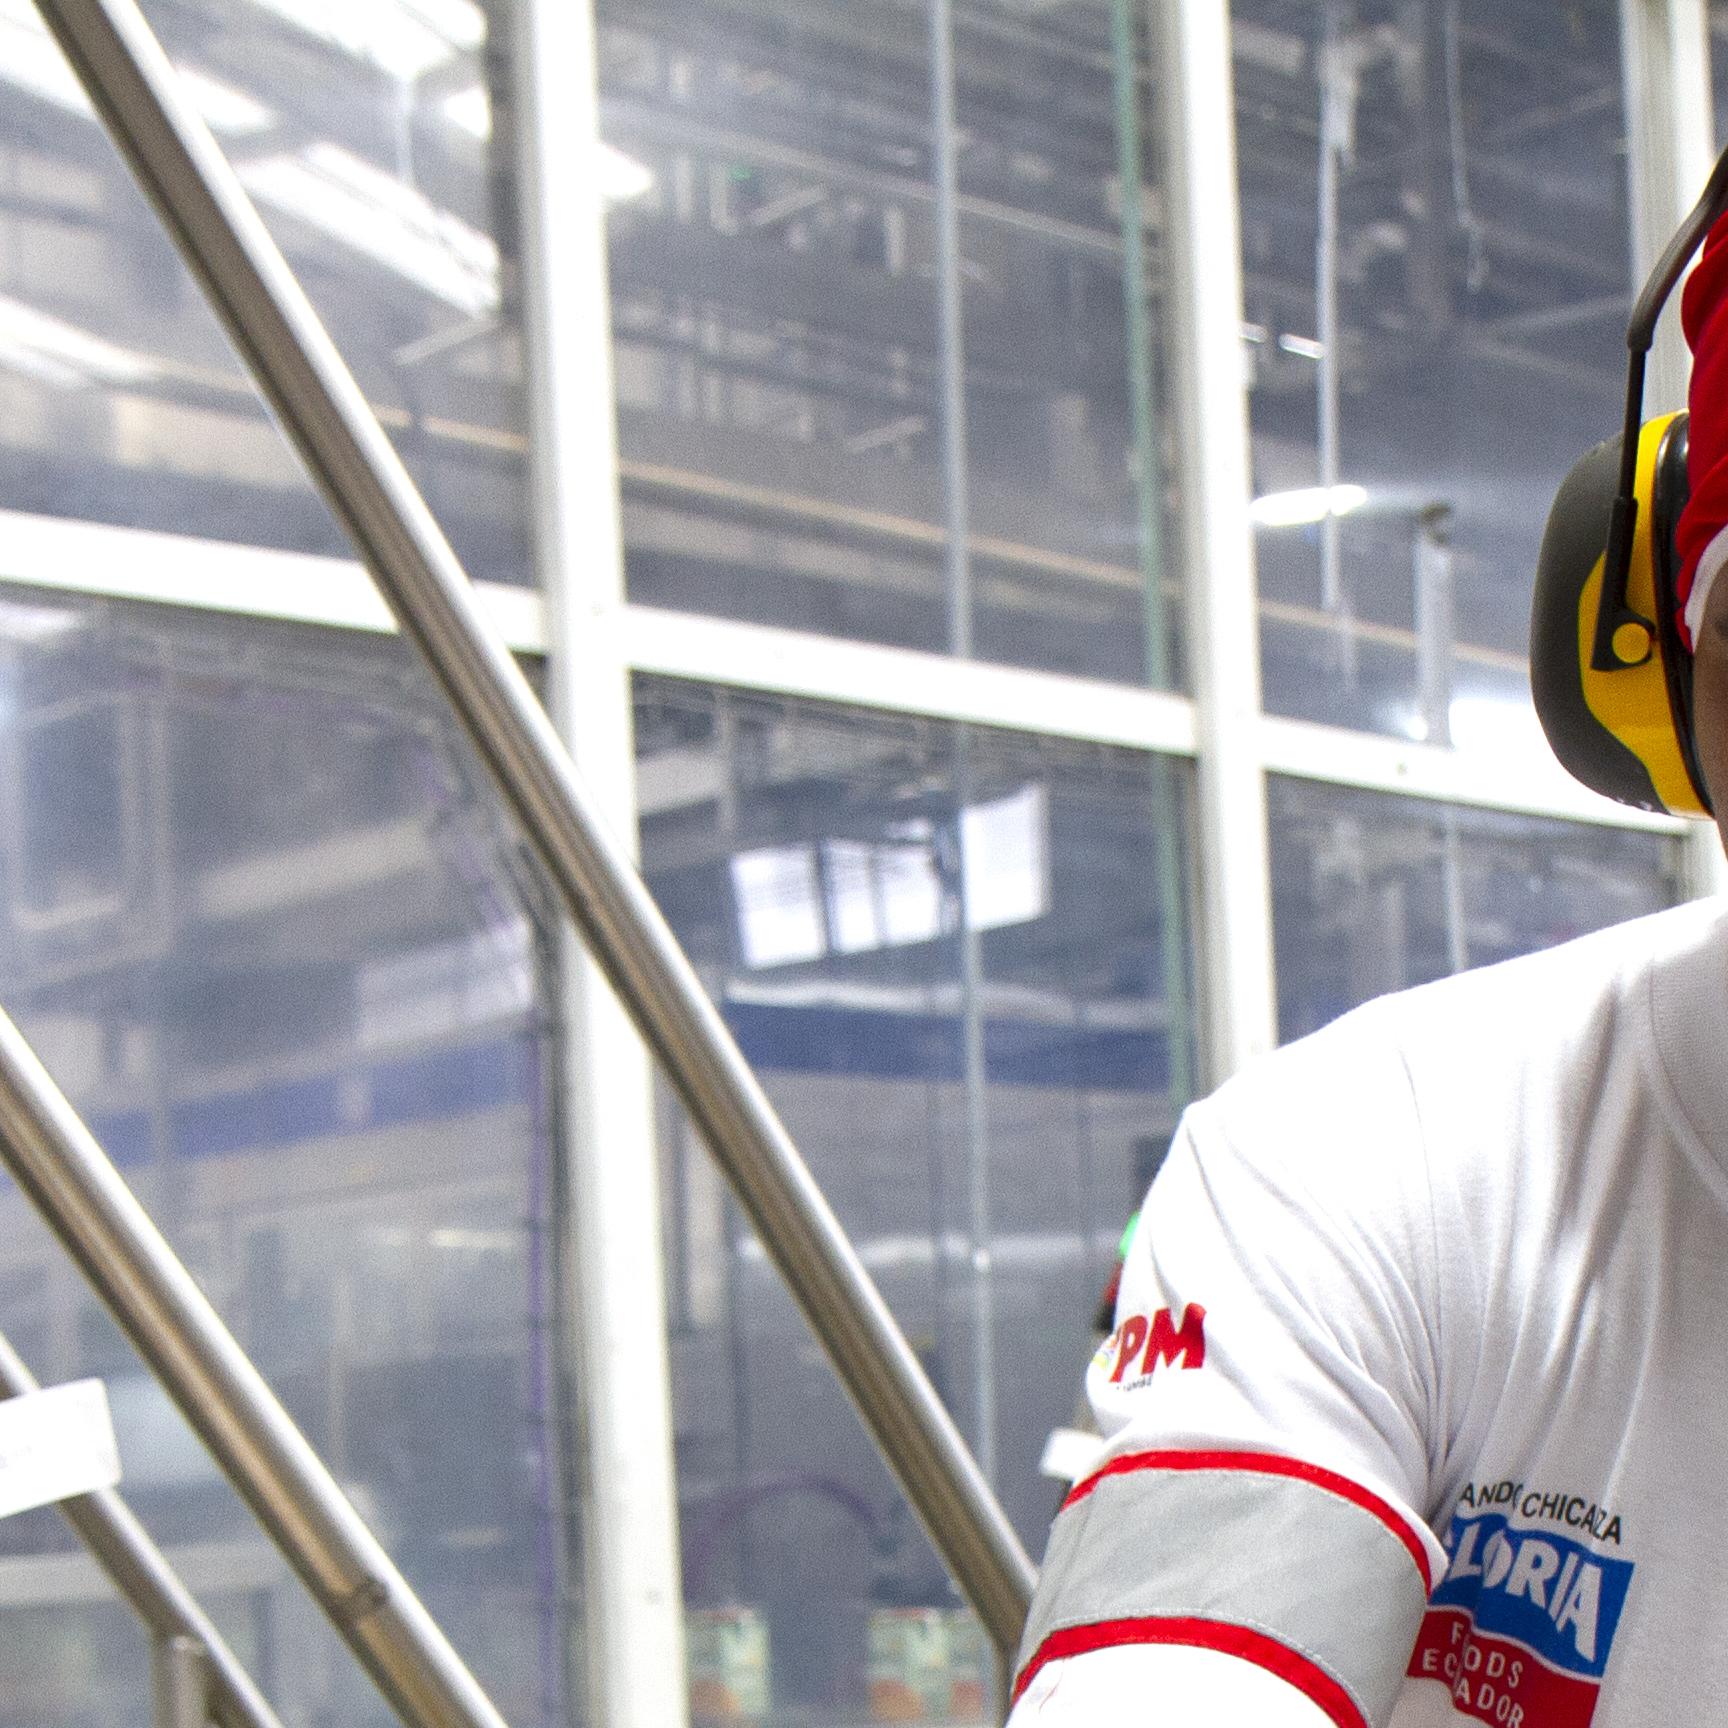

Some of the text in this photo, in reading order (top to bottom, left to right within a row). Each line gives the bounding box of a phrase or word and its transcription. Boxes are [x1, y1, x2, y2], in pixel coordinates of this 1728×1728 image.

[1110, 1302, 1207, 1383] PM
[1445, 1523, 1602, 1663] LORIA
[1452, 1621, 1523, 1688] FODS
